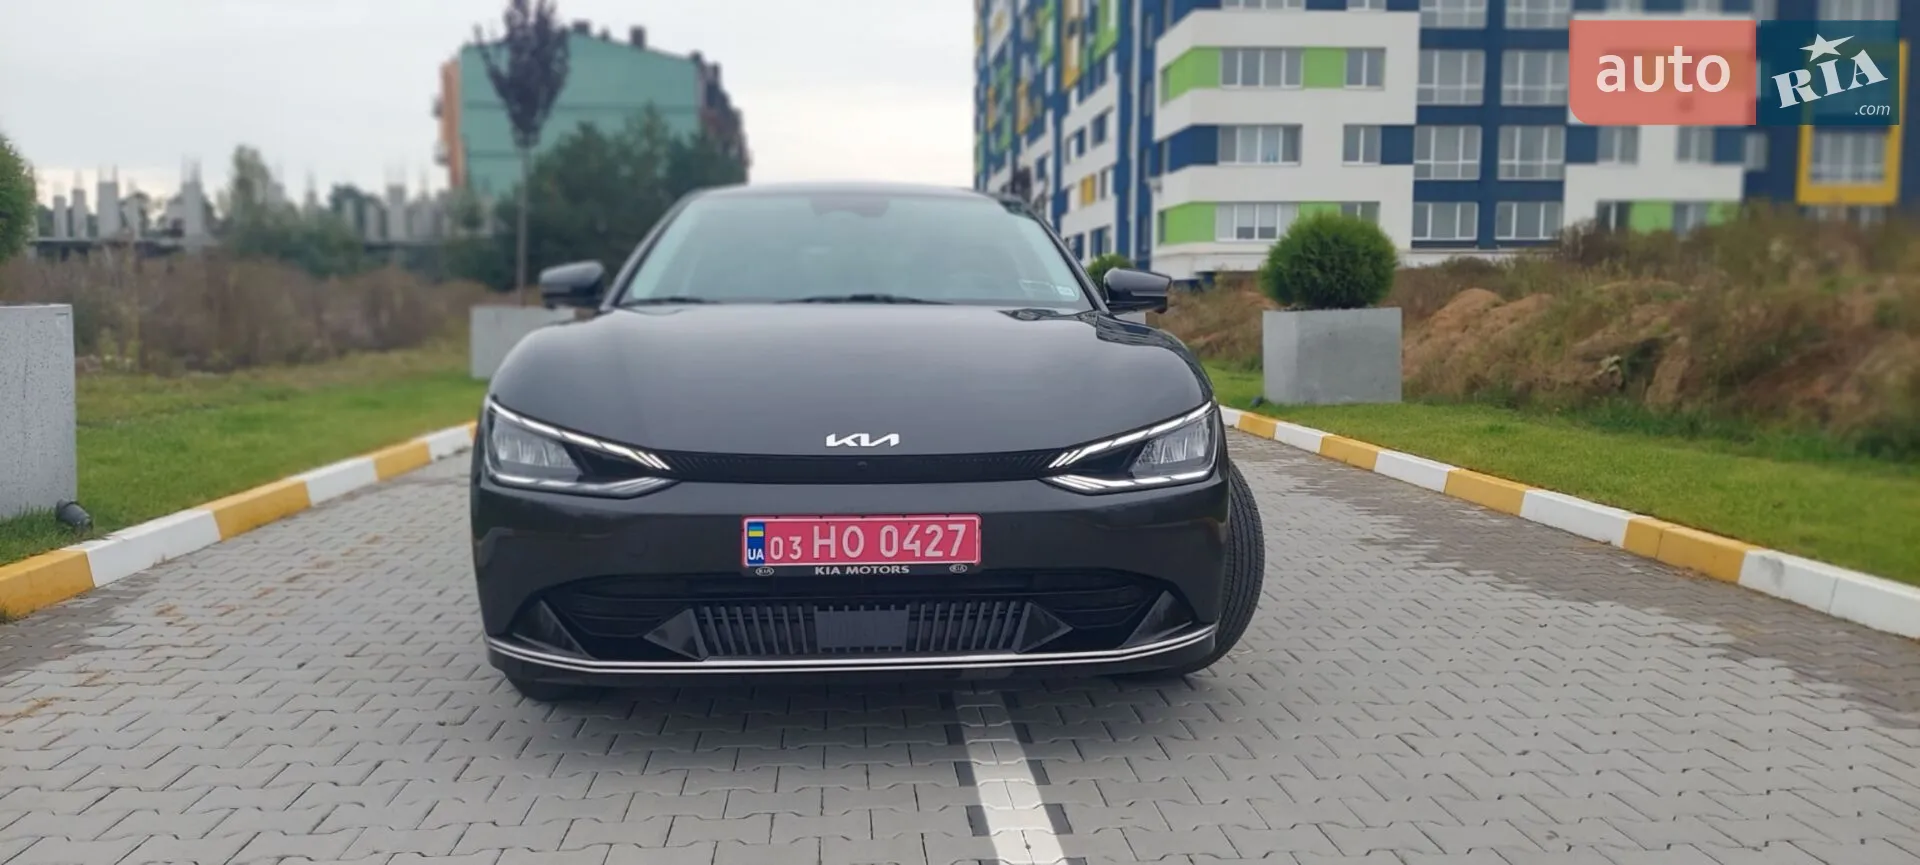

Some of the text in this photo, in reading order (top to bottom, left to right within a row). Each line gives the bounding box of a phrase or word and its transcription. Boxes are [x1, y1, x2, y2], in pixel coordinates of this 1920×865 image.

[826, 433, 900, 447] KIA
[770, 523, 966, 560] 03 HO 0427
[747, 548, 765, 561] UA
[815, 565, 910, 575] KIA MOTORS
